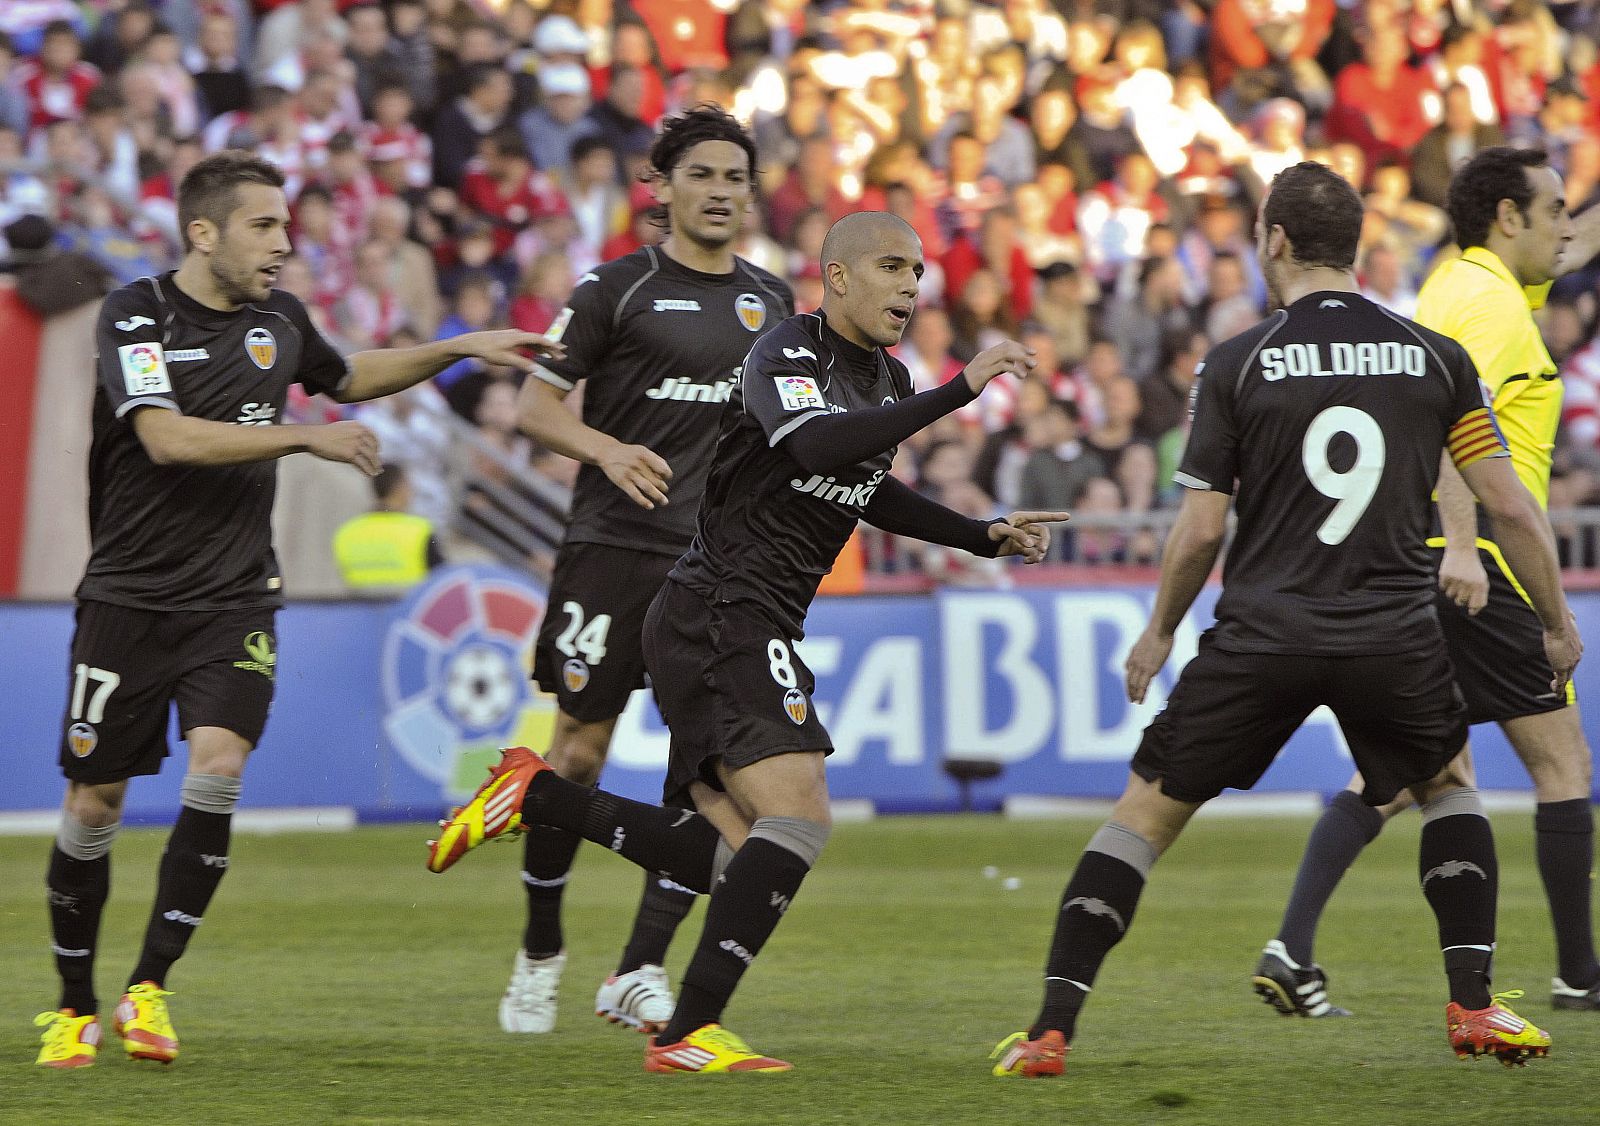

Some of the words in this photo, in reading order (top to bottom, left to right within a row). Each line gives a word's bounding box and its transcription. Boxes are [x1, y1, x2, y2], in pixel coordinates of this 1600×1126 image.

[1260, 342, 1426, 382] SOLDADO
[786, 397, 817, 409] LFP
[790, 474, 878, 506] Jink
[1302, 405, 1387, 545] 9
[555, 600, 612, 666] 24
[767, 638, 798, 689] 8
[70, 663, 121, 724] 17
